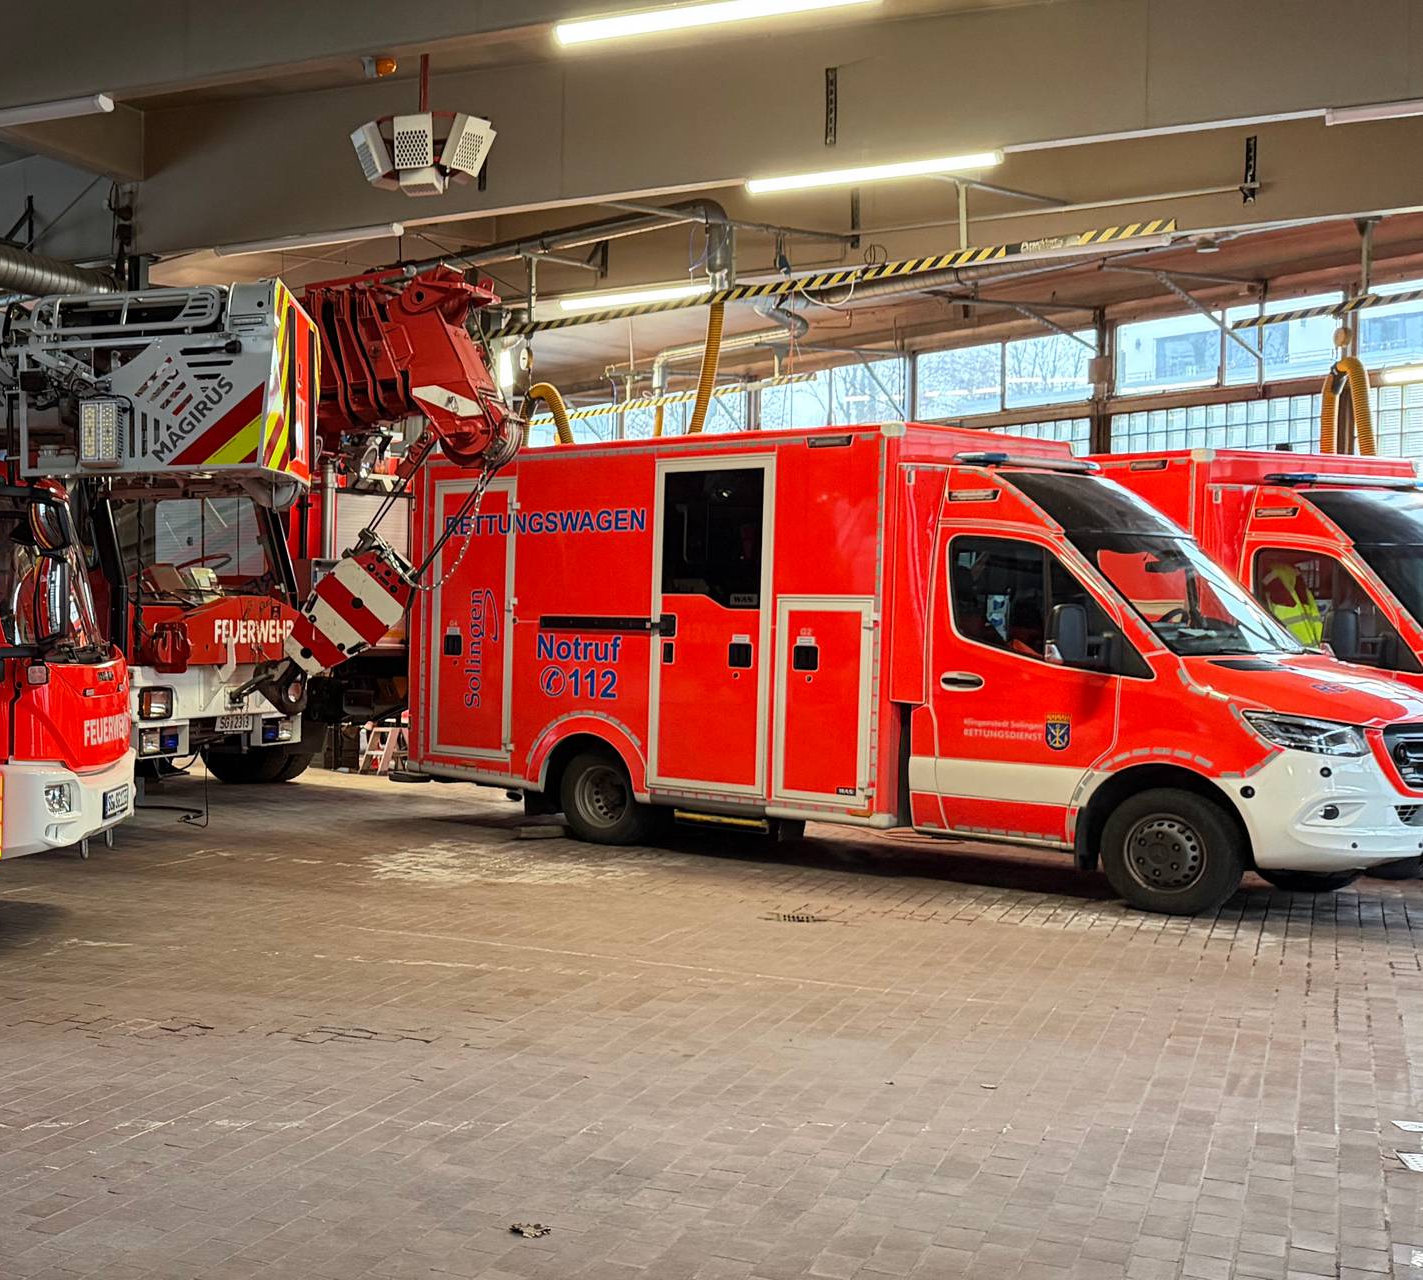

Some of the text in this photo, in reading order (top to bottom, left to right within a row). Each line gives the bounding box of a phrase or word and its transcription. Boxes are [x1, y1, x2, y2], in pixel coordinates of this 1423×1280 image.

[151, 376, 234, 463] MAGIRUS
[445, 508, 647, 537] RETTUNGSWAGEN
[214, 619, 295, 644] FEUERWEHR
[537, 633, 623, 663] Notruf
[568, 667, 618, 699] 112
